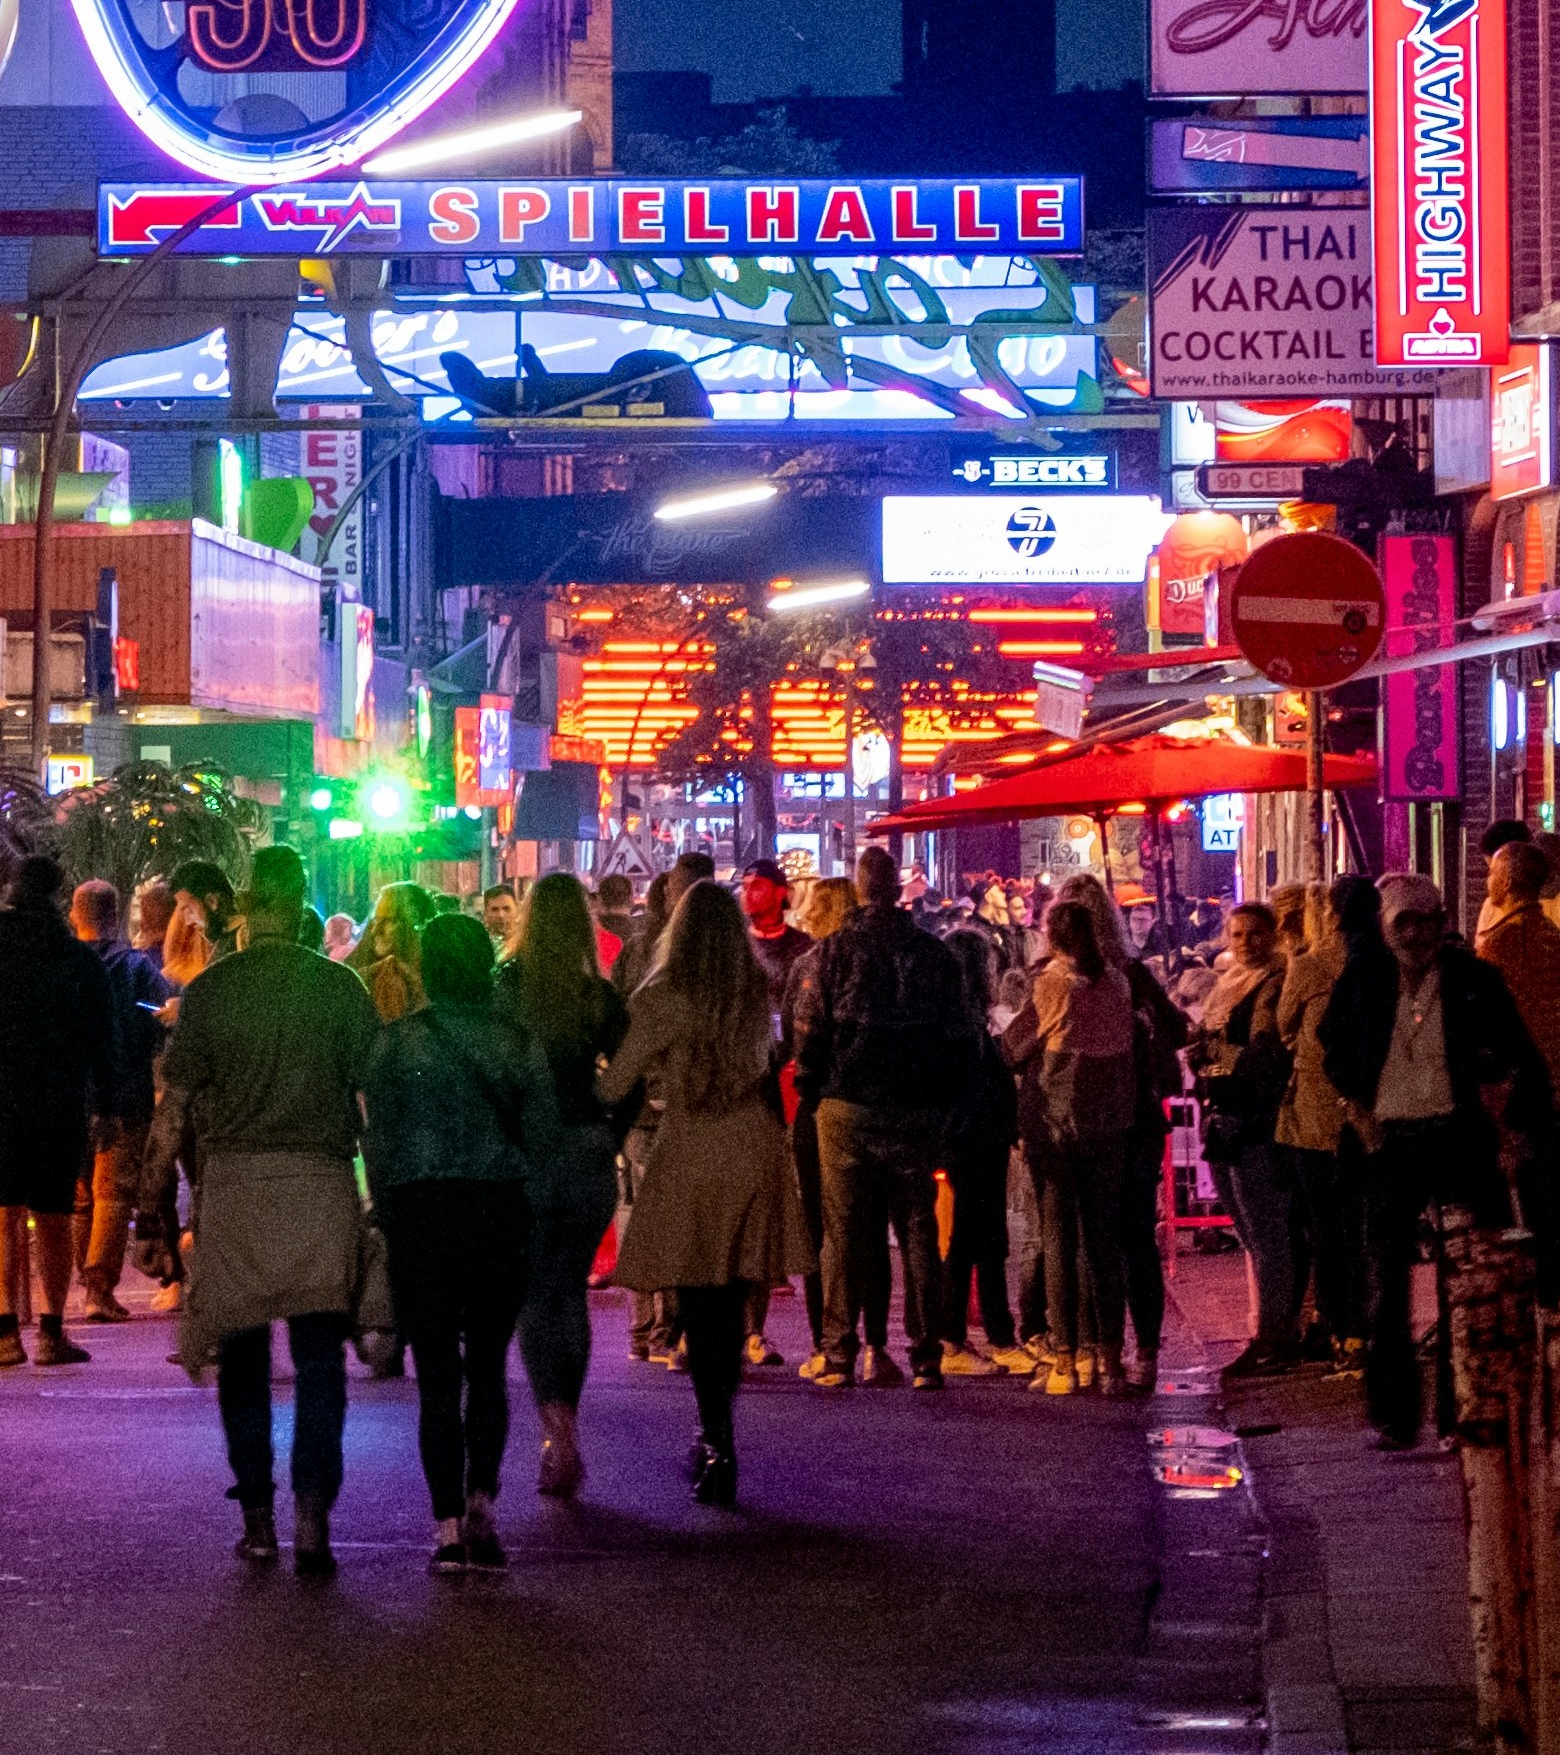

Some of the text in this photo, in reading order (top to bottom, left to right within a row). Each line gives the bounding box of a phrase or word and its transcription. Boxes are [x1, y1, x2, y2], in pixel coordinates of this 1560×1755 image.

[1415, 41, 1468, 303] HIGHWAY
[427, 183, 1066, 244] SPIELHALLE
[1251, 225, 1357, 260] THAI
[1191, 275, 1372, 312] KARAOK
[1158, 330, 1336, 363] COCKTAIL
[1161, 367, 1436, 391] www.thaikaraoke-hamburg.de
[993, 457, 1107, 483] BECK'S
